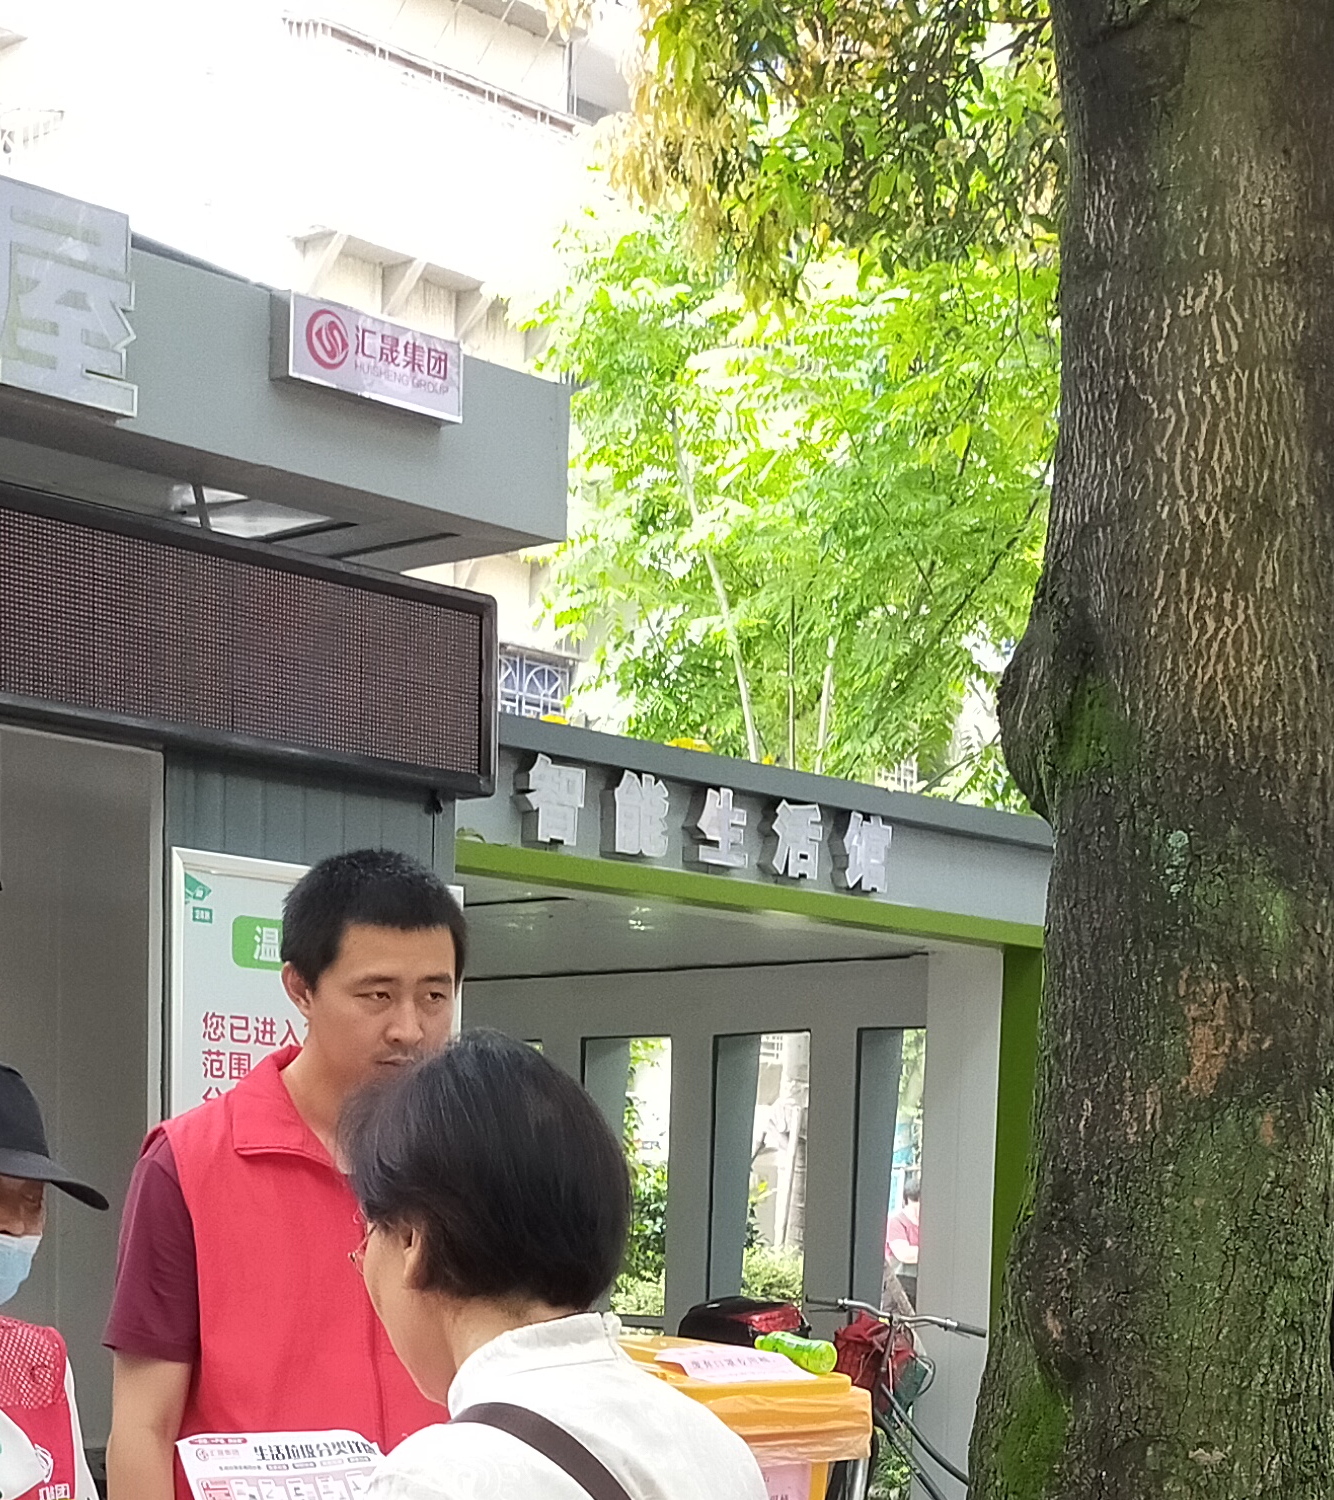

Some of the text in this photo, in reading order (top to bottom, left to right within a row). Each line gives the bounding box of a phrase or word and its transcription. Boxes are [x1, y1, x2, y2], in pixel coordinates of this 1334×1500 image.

[354, 324, 449, 381] 汇晟集团
[354, 360, 449, 396] HUISHENG GROUP
[525, 752, 892, 894] 智能生活馆
[202, 1010, 299, 1047] 您已进入
[202, 1049, 251, 1080] 范围
